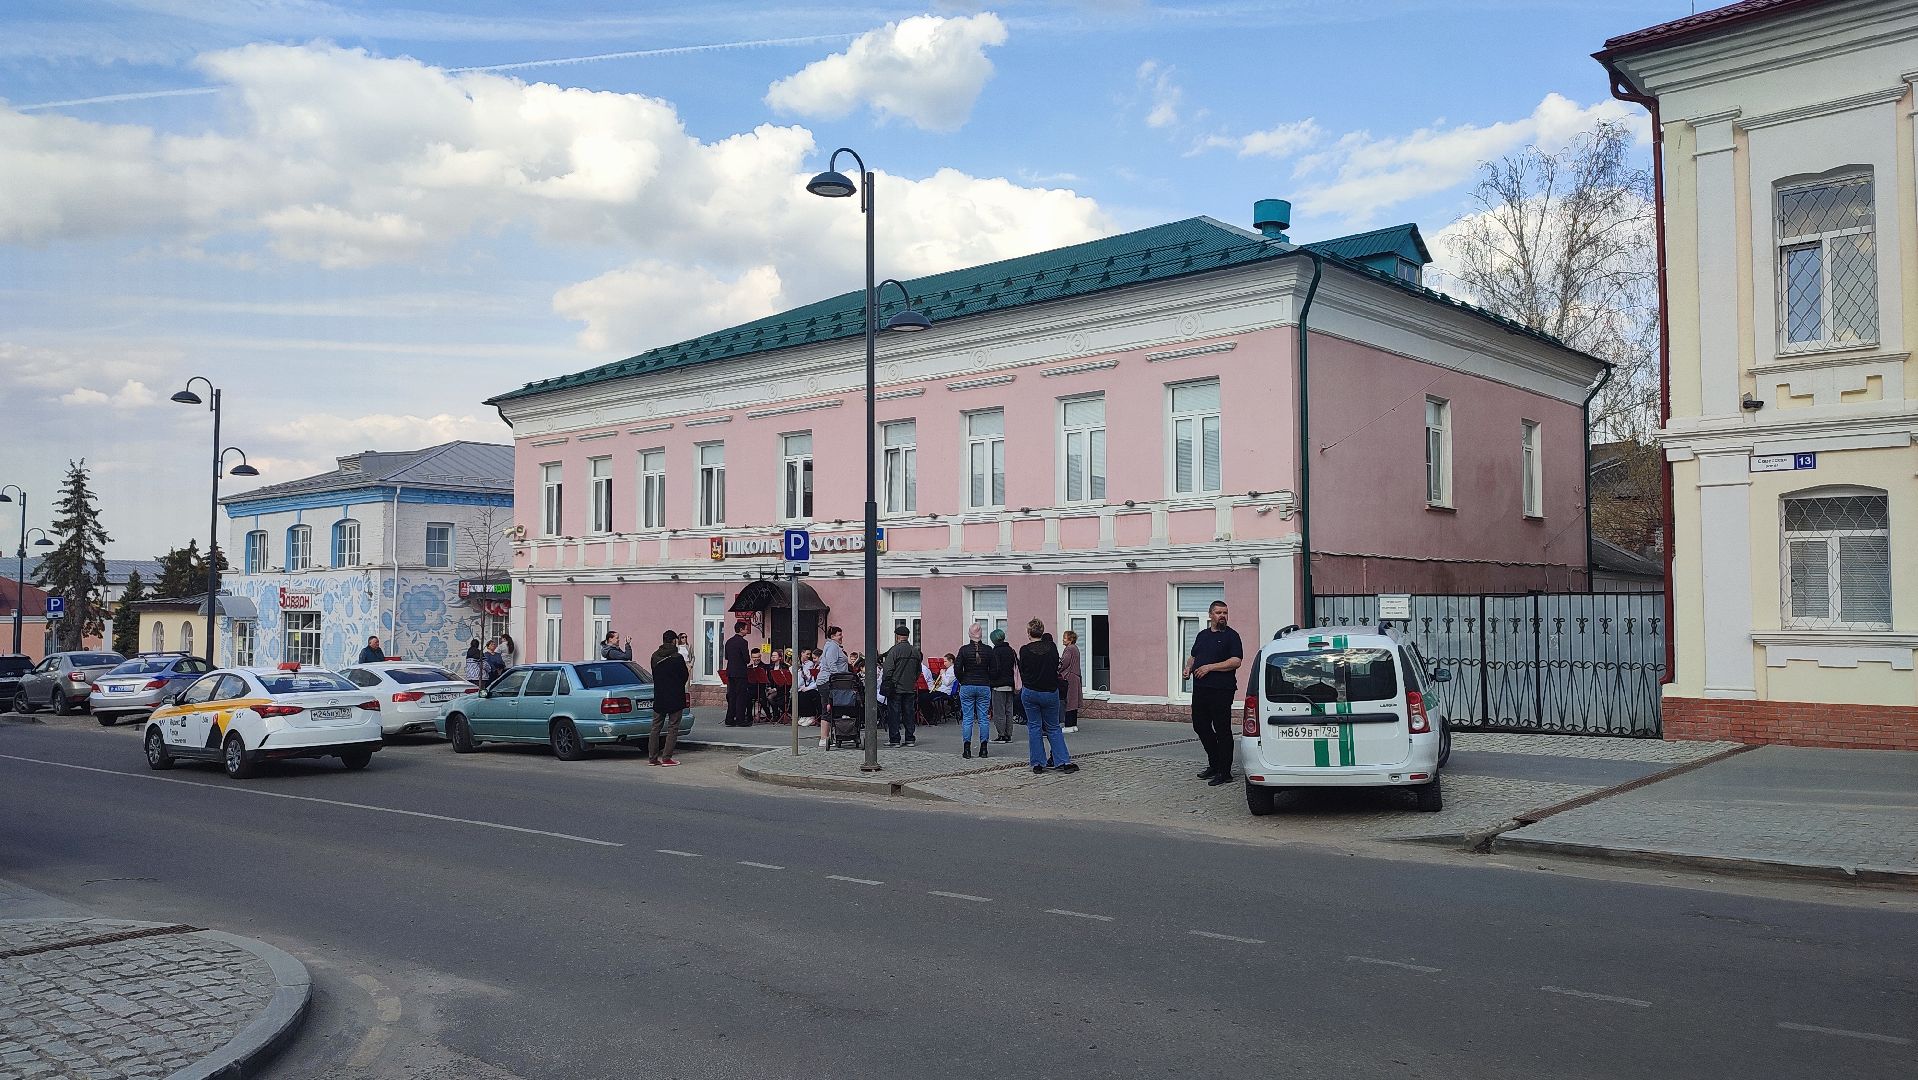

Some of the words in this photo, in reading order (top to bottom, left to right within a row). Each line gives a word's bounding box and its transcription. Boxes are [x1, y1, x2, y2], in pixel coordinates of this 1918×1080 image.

[1799, 456, 1812, 466] 13
[727, 539, 782, 555] ШКОЛА
[790, 534, 805, 557] P
[50, 598, 61, 611] P
[1322, 726, 1337, 735] 790
